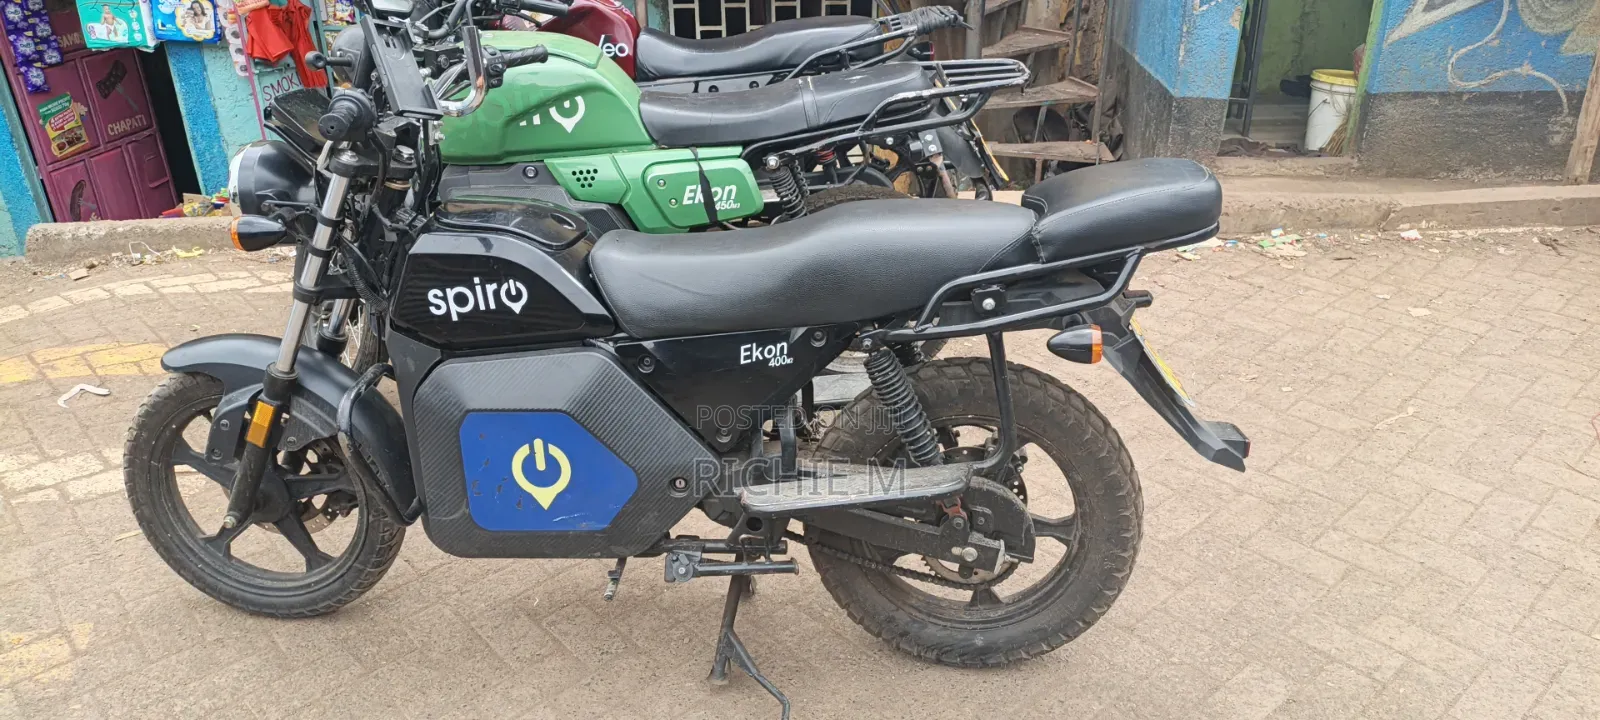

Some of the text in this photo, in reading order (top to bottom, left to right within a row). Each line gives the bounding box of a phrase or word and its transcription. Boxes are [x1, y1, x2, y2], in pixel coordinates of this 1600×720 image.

[107, 114, 147, 135] CHAPATI
[427, 277, 528, 321] spiro
[740, 341, 788, 365] Ekon
